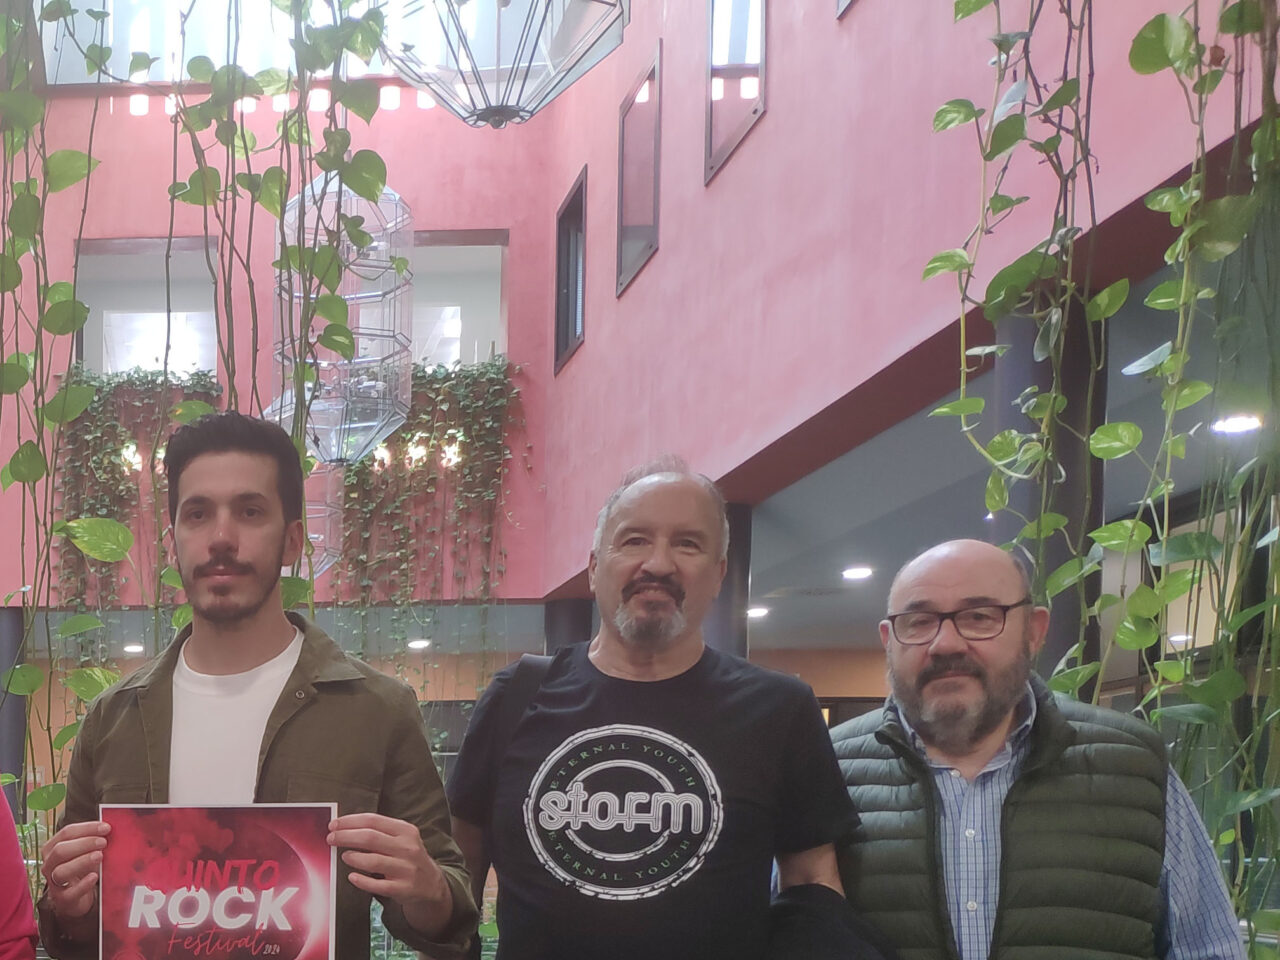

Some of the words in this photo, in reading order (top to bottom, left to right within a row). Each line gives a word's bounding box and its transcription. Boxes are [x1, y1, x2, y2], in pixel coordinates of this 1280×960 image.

[549, 743, 629, 789] ETERNAL
[642, 744, 696, 787] YOUTH
[548, 831, 623, 881] ETERNAL
[635, 839, 691, 879] YOUTH
[128, 885, 300, 931] ROCK
[168, 922, 265, 956] Festival
[263, 944, 281, 955] 2024
